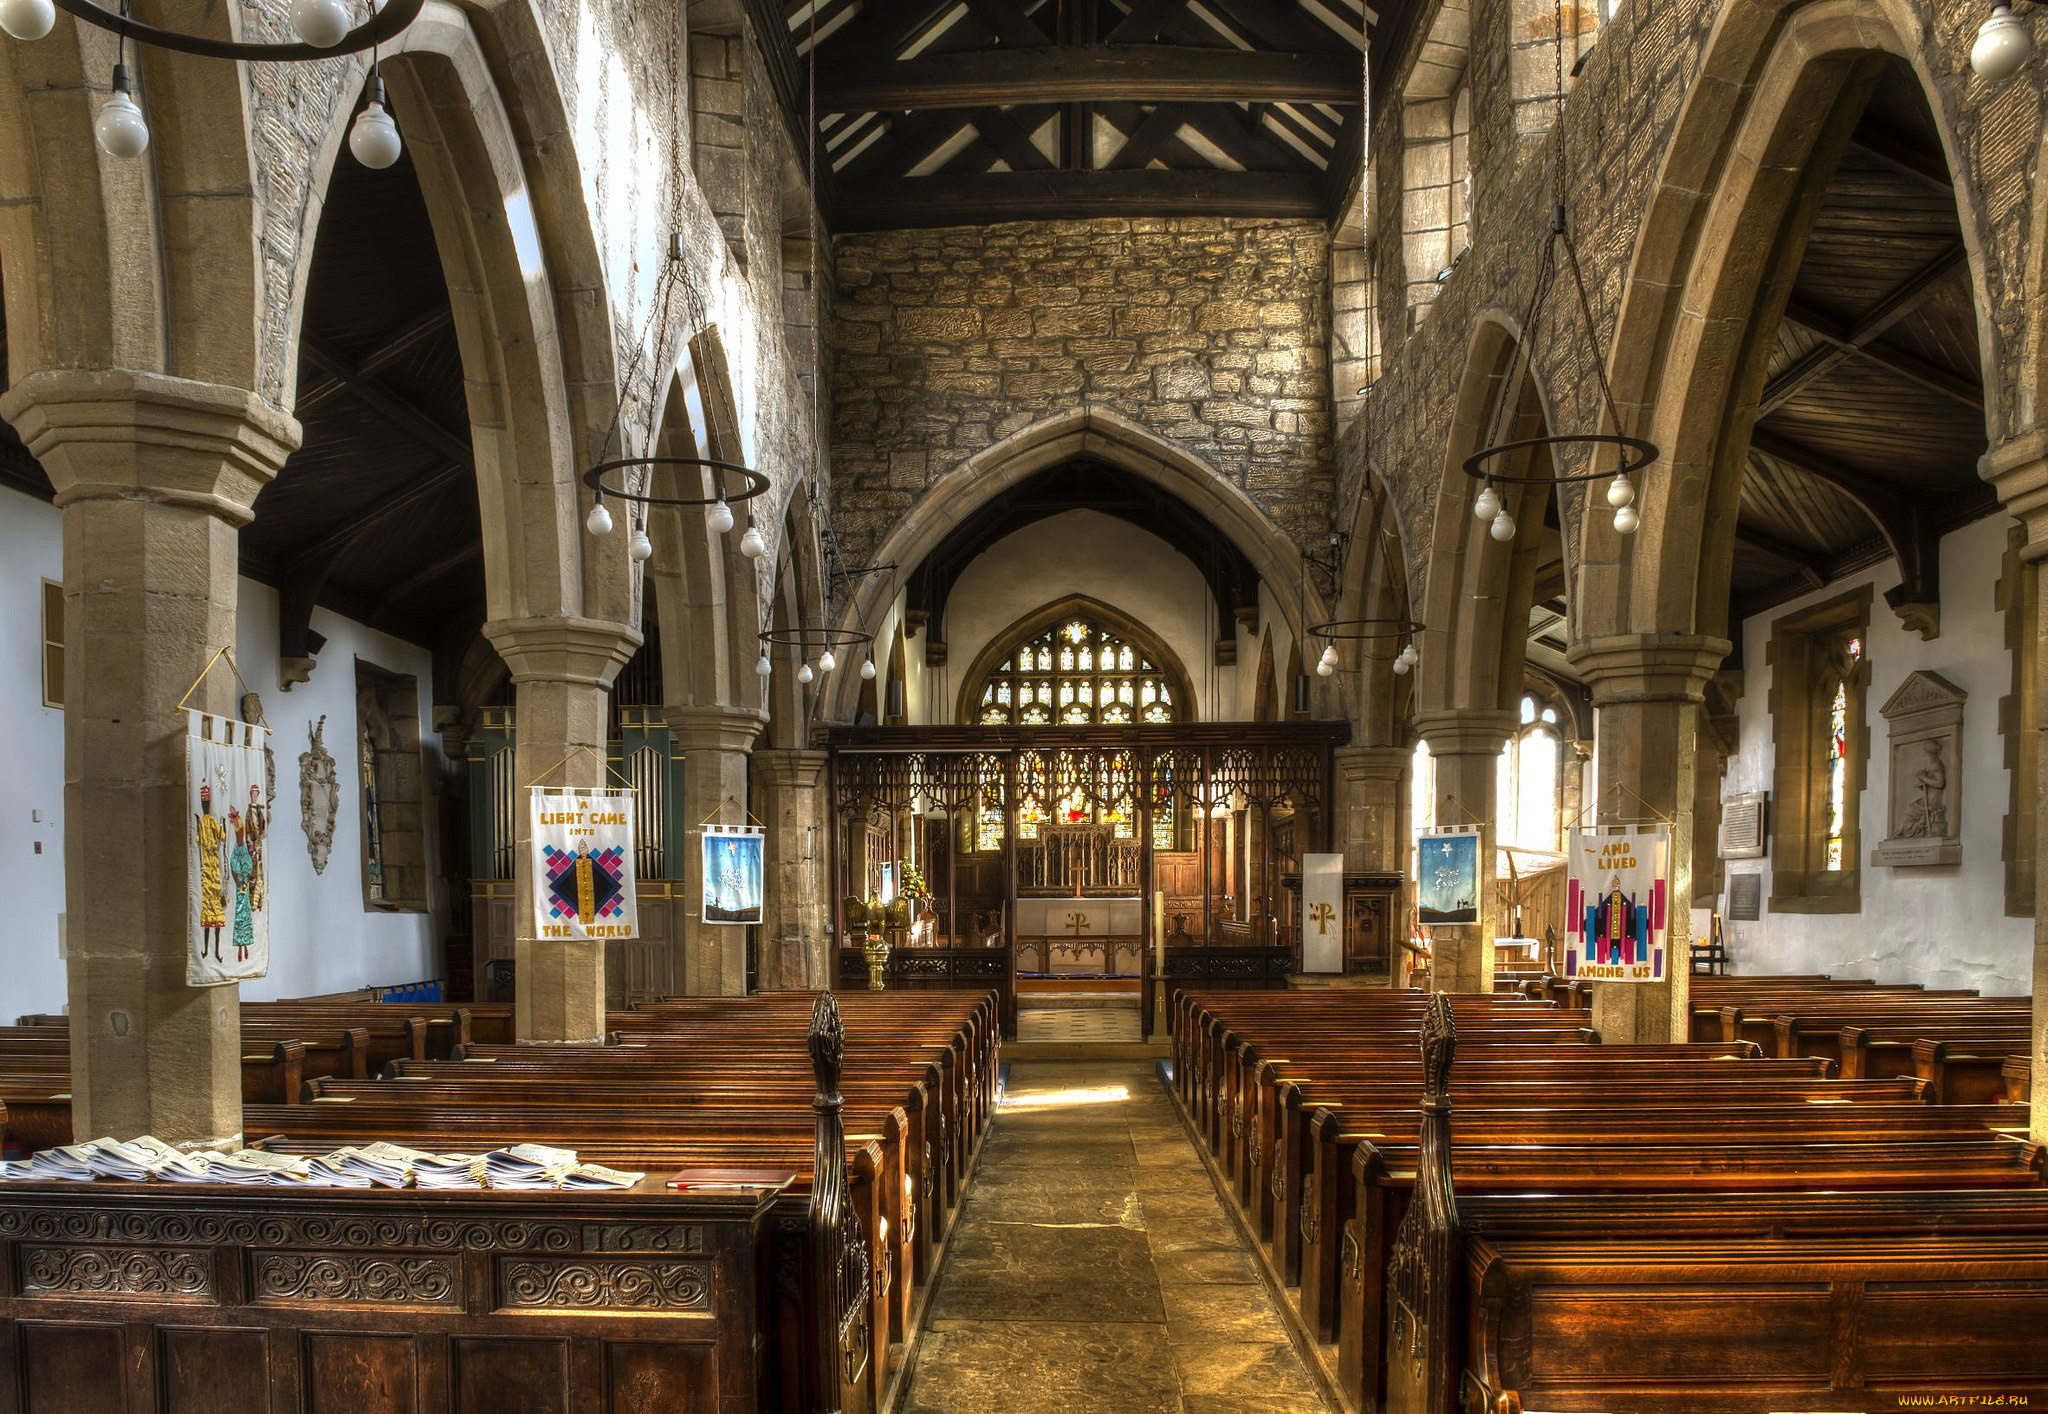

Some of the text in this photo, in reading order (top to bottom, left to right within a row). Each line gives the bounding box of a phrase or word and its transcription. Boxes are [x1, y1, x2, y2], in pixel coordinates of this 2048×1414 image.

[580, 801, 588, 809] A
[540, 813, 627, 825] LIGHT CAME
[569, 828, 595, 836] INTO
[1602, 843, 1630, 856] AND
[1598, 857, 1637, 870] LIVED
[542, 925, 632, 937] THE WORLD
[1577, 966, 1650, 978] AMONG US
